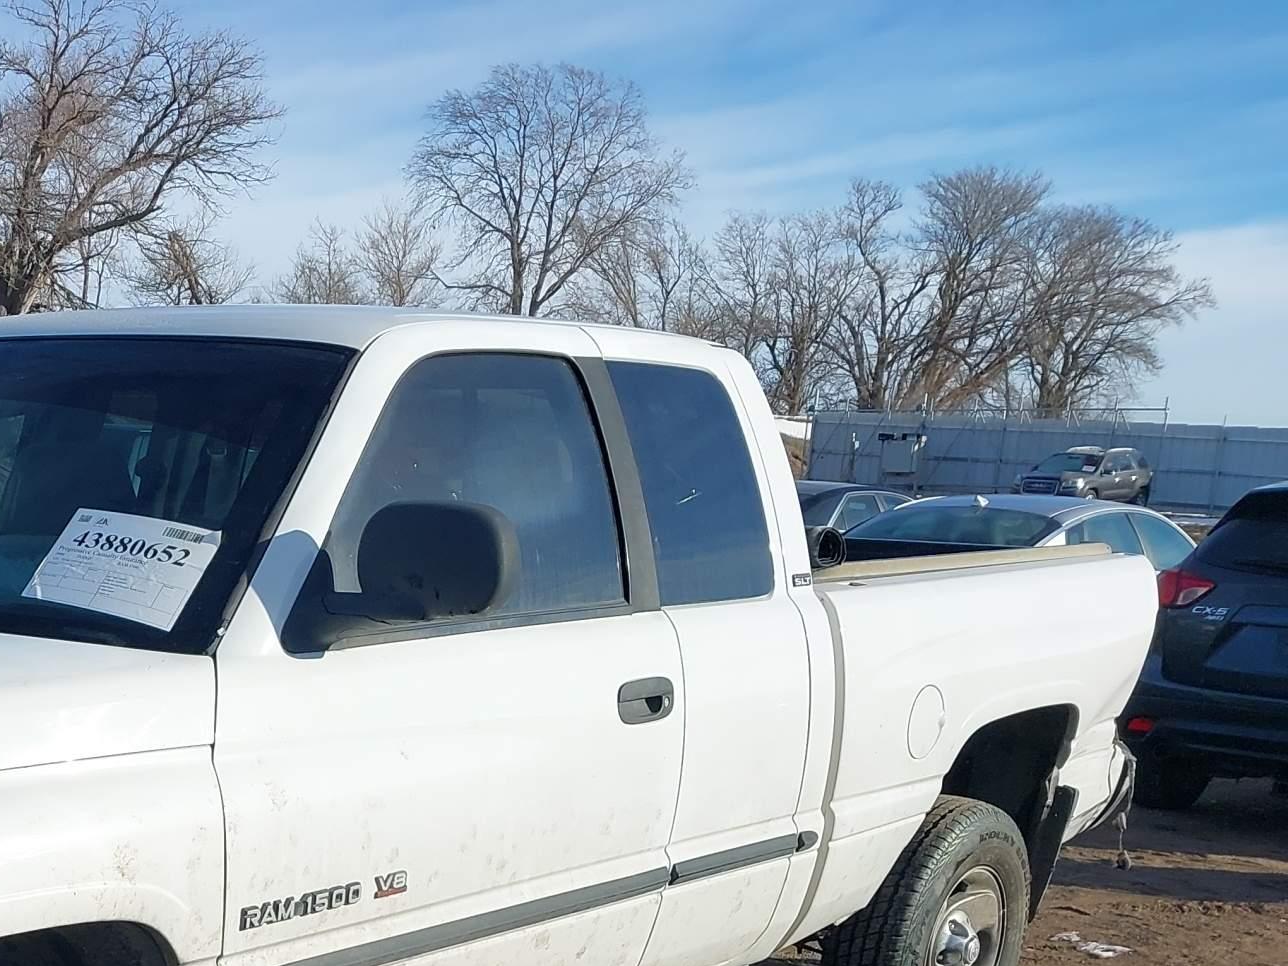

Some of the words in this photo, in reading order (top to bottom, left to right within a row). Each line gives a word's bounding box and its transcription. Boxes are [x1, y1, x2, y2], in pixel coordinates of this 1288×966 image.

[73, 530, 191, 566] 43880652
[794, 577, 810, 586] SLT
[1191, 606, 1230, 615] CX-5
[374, 870, 408, 892] V8
[239, 897, 297, 931] RAM
[297, 882, 362, 916] 1500
